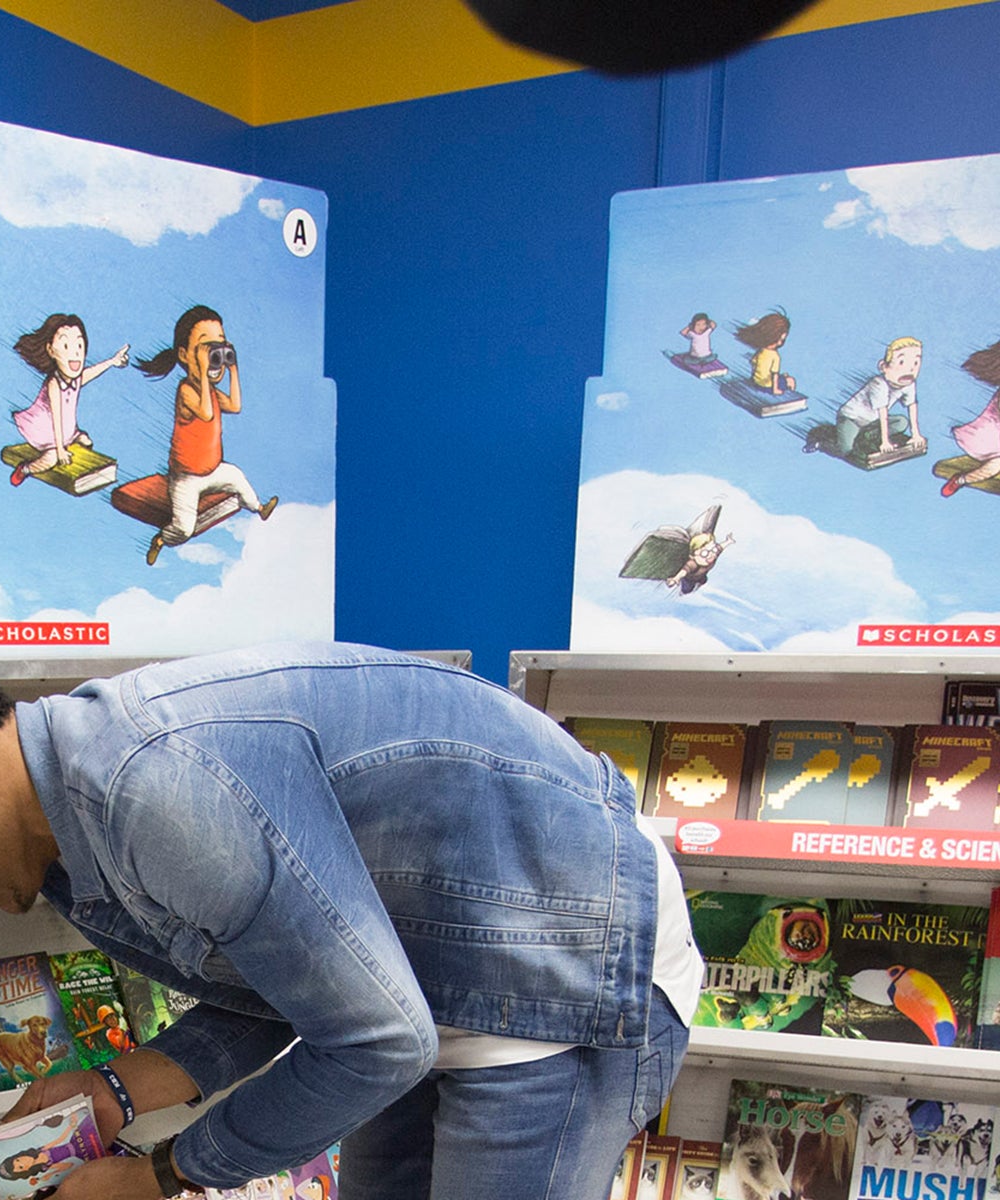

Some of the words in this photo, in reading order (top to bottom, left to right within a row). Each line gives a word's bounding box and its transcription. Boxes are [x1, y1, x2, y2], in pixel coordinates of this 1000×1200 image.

[293, 218, 307, 246] A
[883, 629, 996, 643] SCHOLAS
[671, 733, 736, 744] MINECRAFT
[777, 731, 842, 741] MINECRAFT
[922, 736, 993, 748] MINECRAFT
[792, 831, 915, 859] REFERENCE
[919, 838, 938, 860] &
[887, 912, 908, 927] IN
[911, 914, 950, 930] THE
[841, 923, 974, 947] RAINFOREST
[0, 972, 45, 1001] TIME
[58, 978, 83, 990] RACE
[82, 976, 99, 987] THE
[81, 985, 99, 994] FOREST
[736, 1096, 849, 1137] Horse
